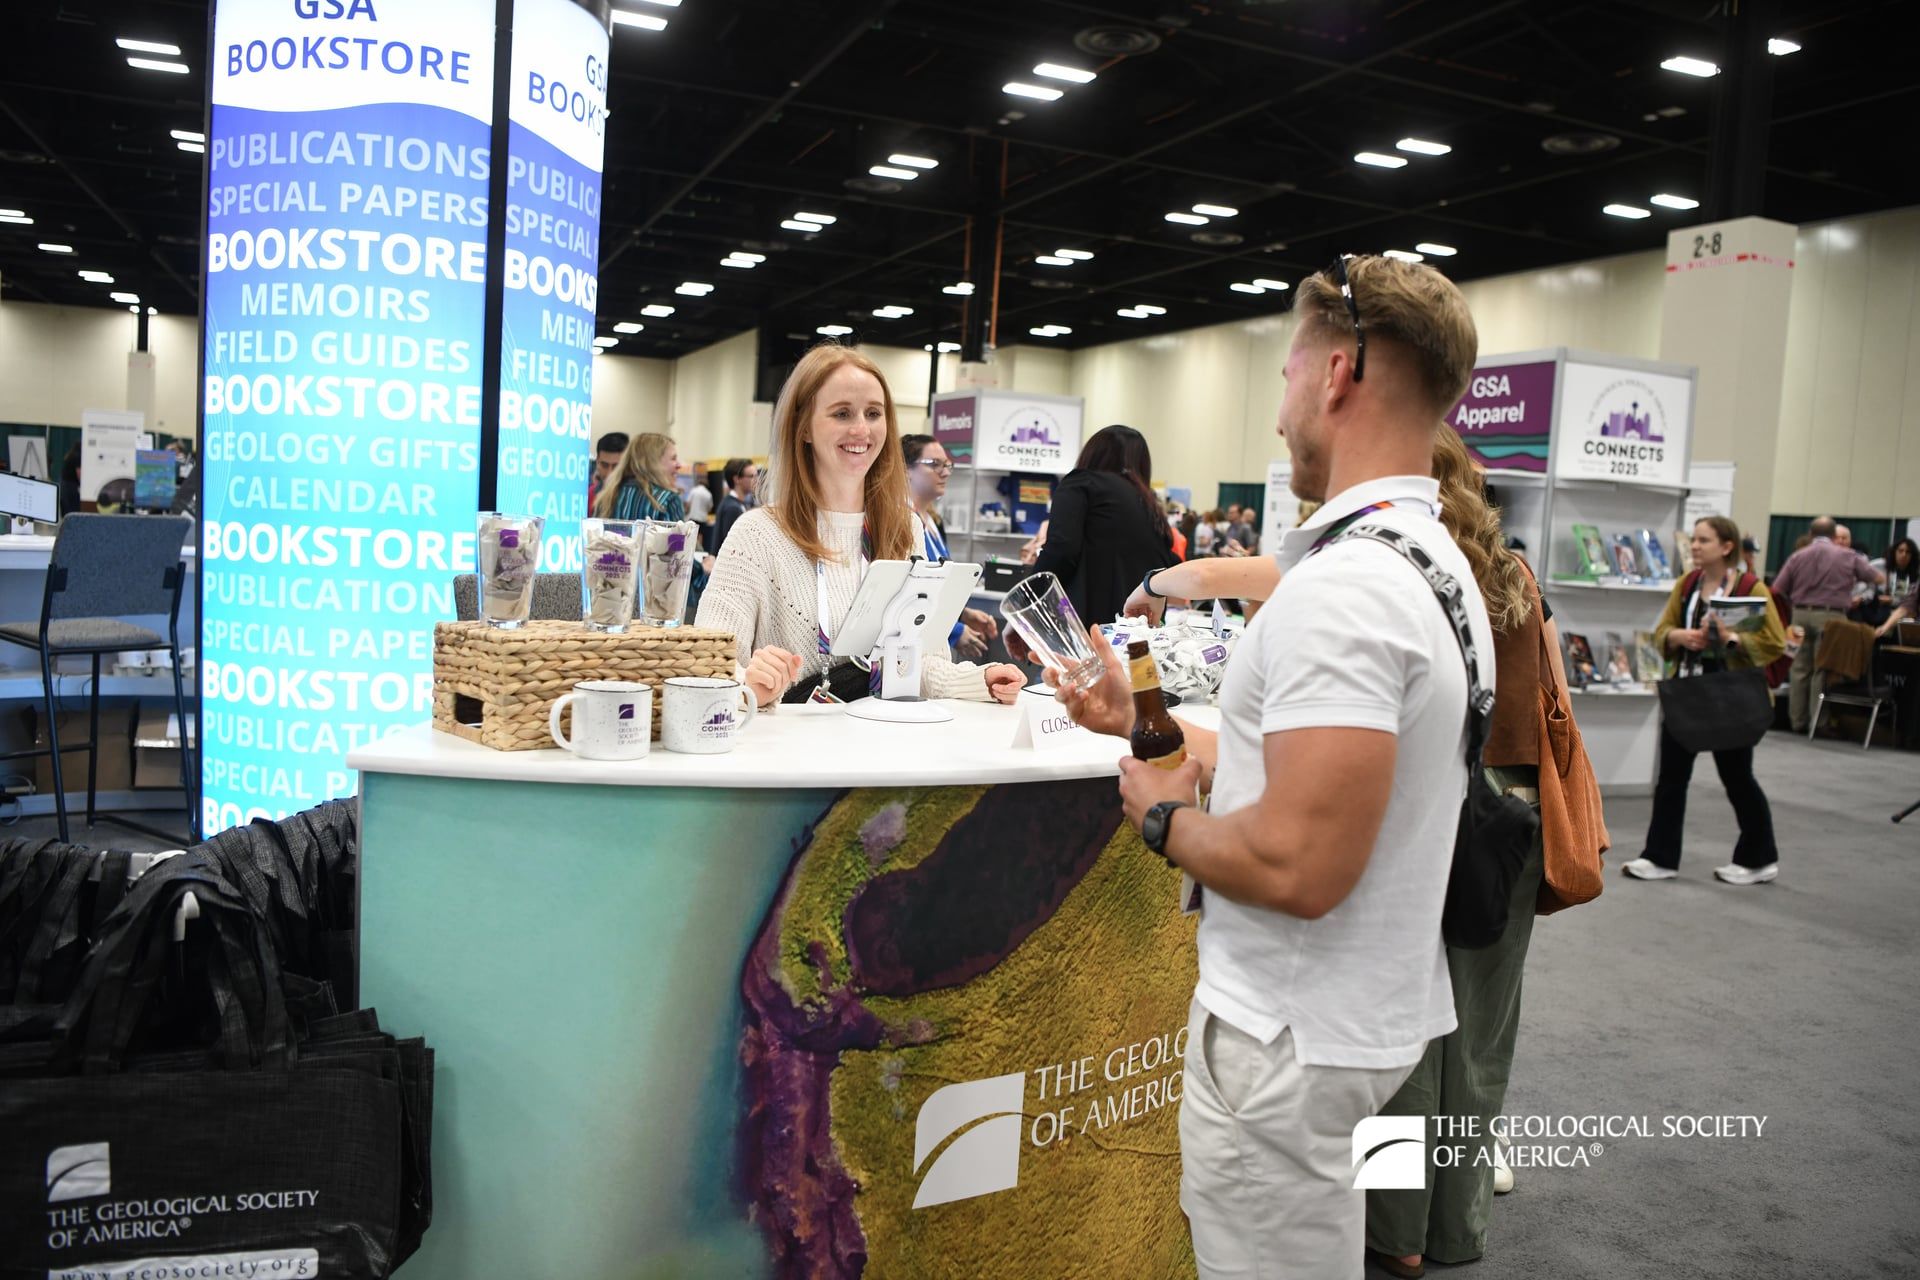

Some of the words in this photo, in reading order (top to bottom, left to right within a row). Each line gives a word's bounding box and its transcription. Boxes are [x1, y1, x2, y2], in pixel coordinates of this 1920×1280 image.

[295, 0, 377, 21] GSA
[228, 36, 471, 85] BOOKSTORE
[211, 130, 490, 181] PUBLICATIONS
[209, 181, 326, 218] SPECIAL
[340, 182, 489, 227] PAPERS
[505, 203, 592, 261] SPECIAL
[208, 227, 486, 283] BOOKSTORE
[241, 282, 430, 323] MEMOIRS
[504, 247, 597, 316] BOOKS
[215, 330, 298, 363] FIELD
[311, 331, 470, 373] GUIDES
[512, 348, 579, 390] FIELD
[205, 373, 482, 426] BOOKSTORE
[1472, 374, 1511, 398] GSA
[500, 389, 592, 441] BOOKS
[1455, 400, 1525, 429] Apparel
[207, 431, 356, 465] GEOLOGY
[369, 437, 478, 472] GIFTS
[998, 445, 1061, 459] CONNECTS
[1584, 440, 1664, 462] CONNECTS
[1611, 461, 1638, 475] 2025
[228, 475, 438, 517] CALENDAR
[203, 520, 476, 571] BOOKSTORE
[203, 618, 315, 657] SPECIAL
[203, 756, 312, 800] SPECIAL
[1034, 1056, 1094, 1100] THE
[1031, 1106, 1074, 1147] OF
[1081, 1070, 1184, 1135] AMERIC
[48, 1207, 89, 1228] THE
[97, 1196, 231, 1221] GEOLOGICAL
[236, 1190, 319, 1210] SOCIETY
[49, 1230, 78, 1249] OF
